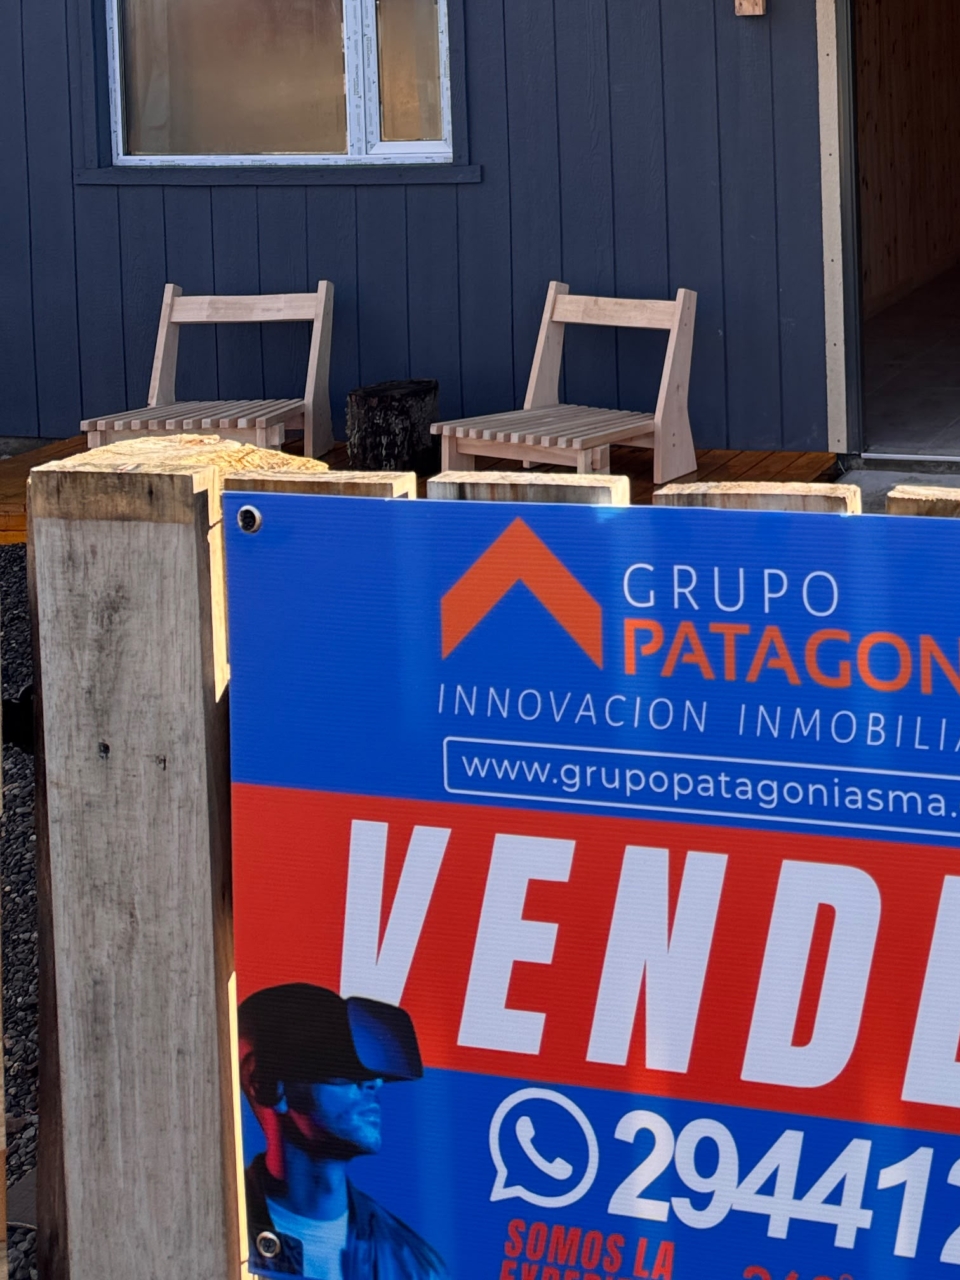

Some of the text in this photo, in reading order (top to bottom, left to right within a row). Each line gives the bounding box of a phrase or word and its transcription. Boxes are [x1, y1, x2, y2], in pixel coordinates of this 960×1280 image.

[622, 562, 838, 617] GRUPO
[438, 683, 707, 733] INNOVACION
[504, 1218, 626, 1273] SOMOS
[632, 1236, 676, 1280] LA
